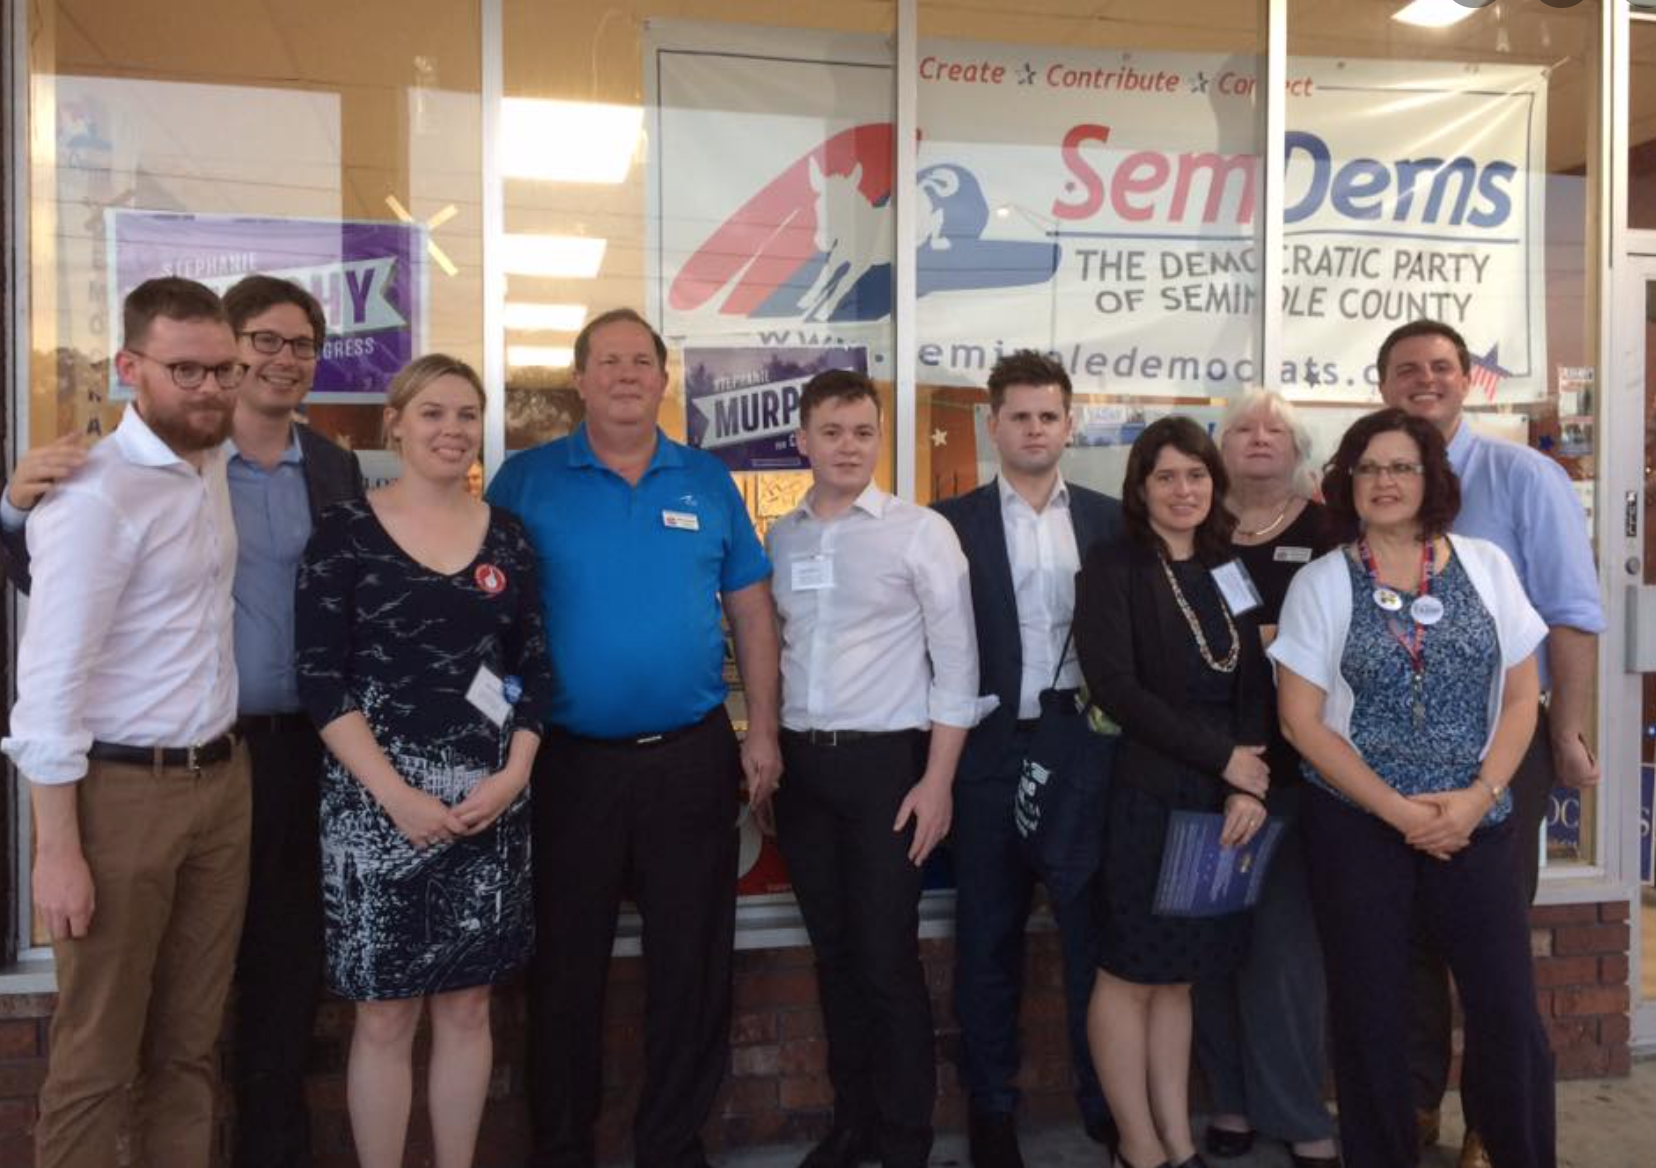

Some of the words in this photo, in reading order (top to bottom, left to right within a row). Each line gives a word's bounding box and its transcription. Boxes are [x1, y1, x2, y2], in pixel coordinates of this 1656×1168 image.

[919, 56, 1006, 84] Create
[1046, 64, 1180, 93] Contribute
[1218, 71, 1314, 97] Conct
[1075, 249, 1147, 282] THE
[1393, 249, 1490, 284] PARTY
[1095, 288, 1145, 314] OF
[1338, 287, 1473, 322] COUNTY
[714, 385, 802, 438] MURP
